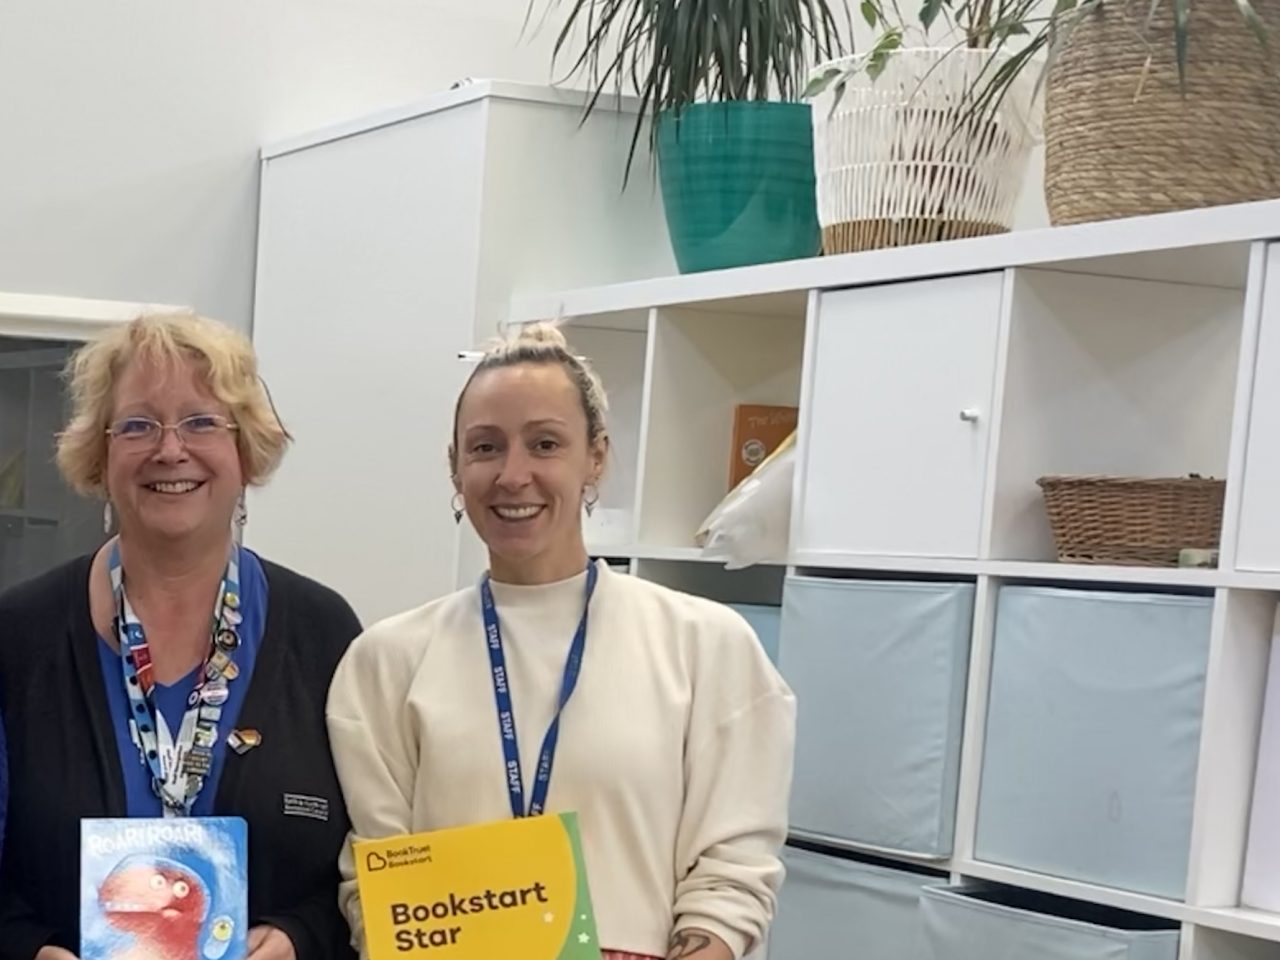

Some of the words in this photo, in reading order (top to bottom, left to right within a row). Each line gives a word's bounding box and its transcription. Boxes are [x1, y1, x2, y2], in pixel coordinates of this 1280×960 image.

[500, 711, 515, 740] STAFF
[507, 760, 521, 793] STAFF
[390, 881, 549, 926] Bookstart
[395, 926, 462, 952] Star
